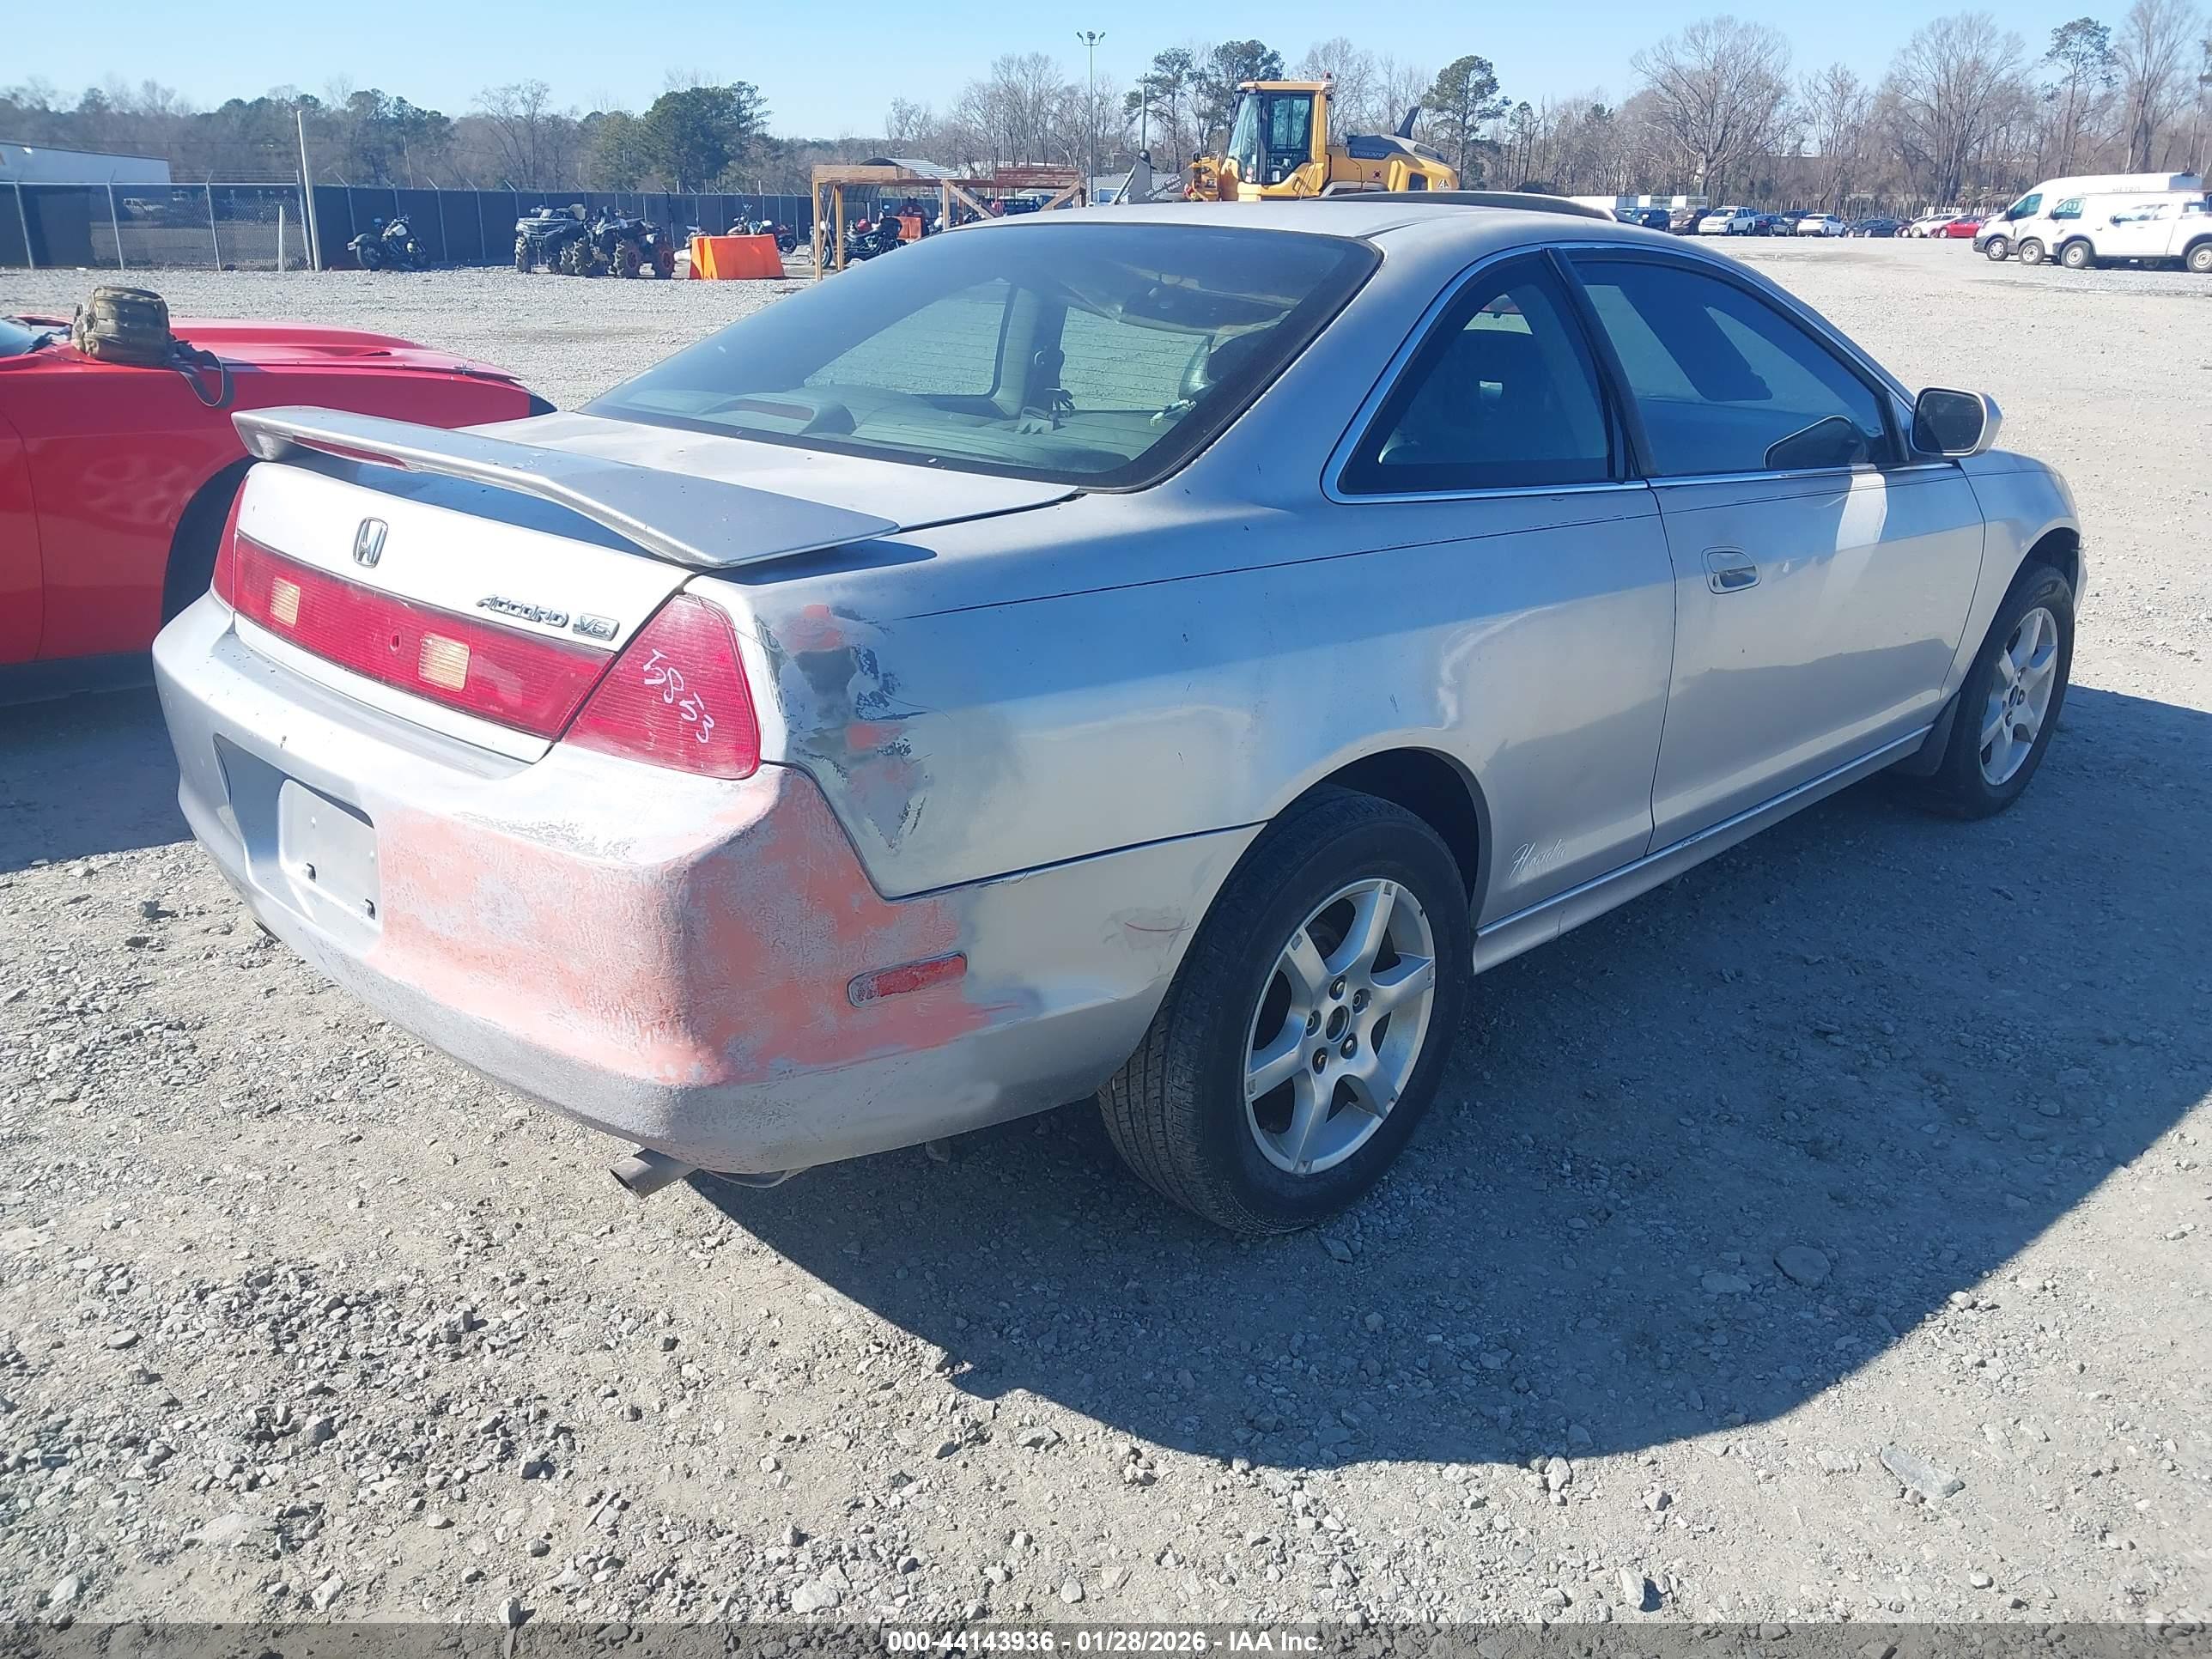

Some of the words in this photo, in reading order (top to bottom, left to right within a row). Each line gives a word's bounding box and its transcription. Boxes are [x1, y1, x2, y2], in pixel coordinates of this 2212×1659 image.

[1145, 189, 1154, 198] DO
[1154, 182, 1166, 191] NOT
[1165, 174, 1182, 185] WALK
[1150, 188, 1169, 201] UNDER
[1168, 180, 1182, 191] MAST
[577, 614, 614, 639] V6
[642, 648, 714, 744] 5853
[1509, 838, 1566, 879] Honda
